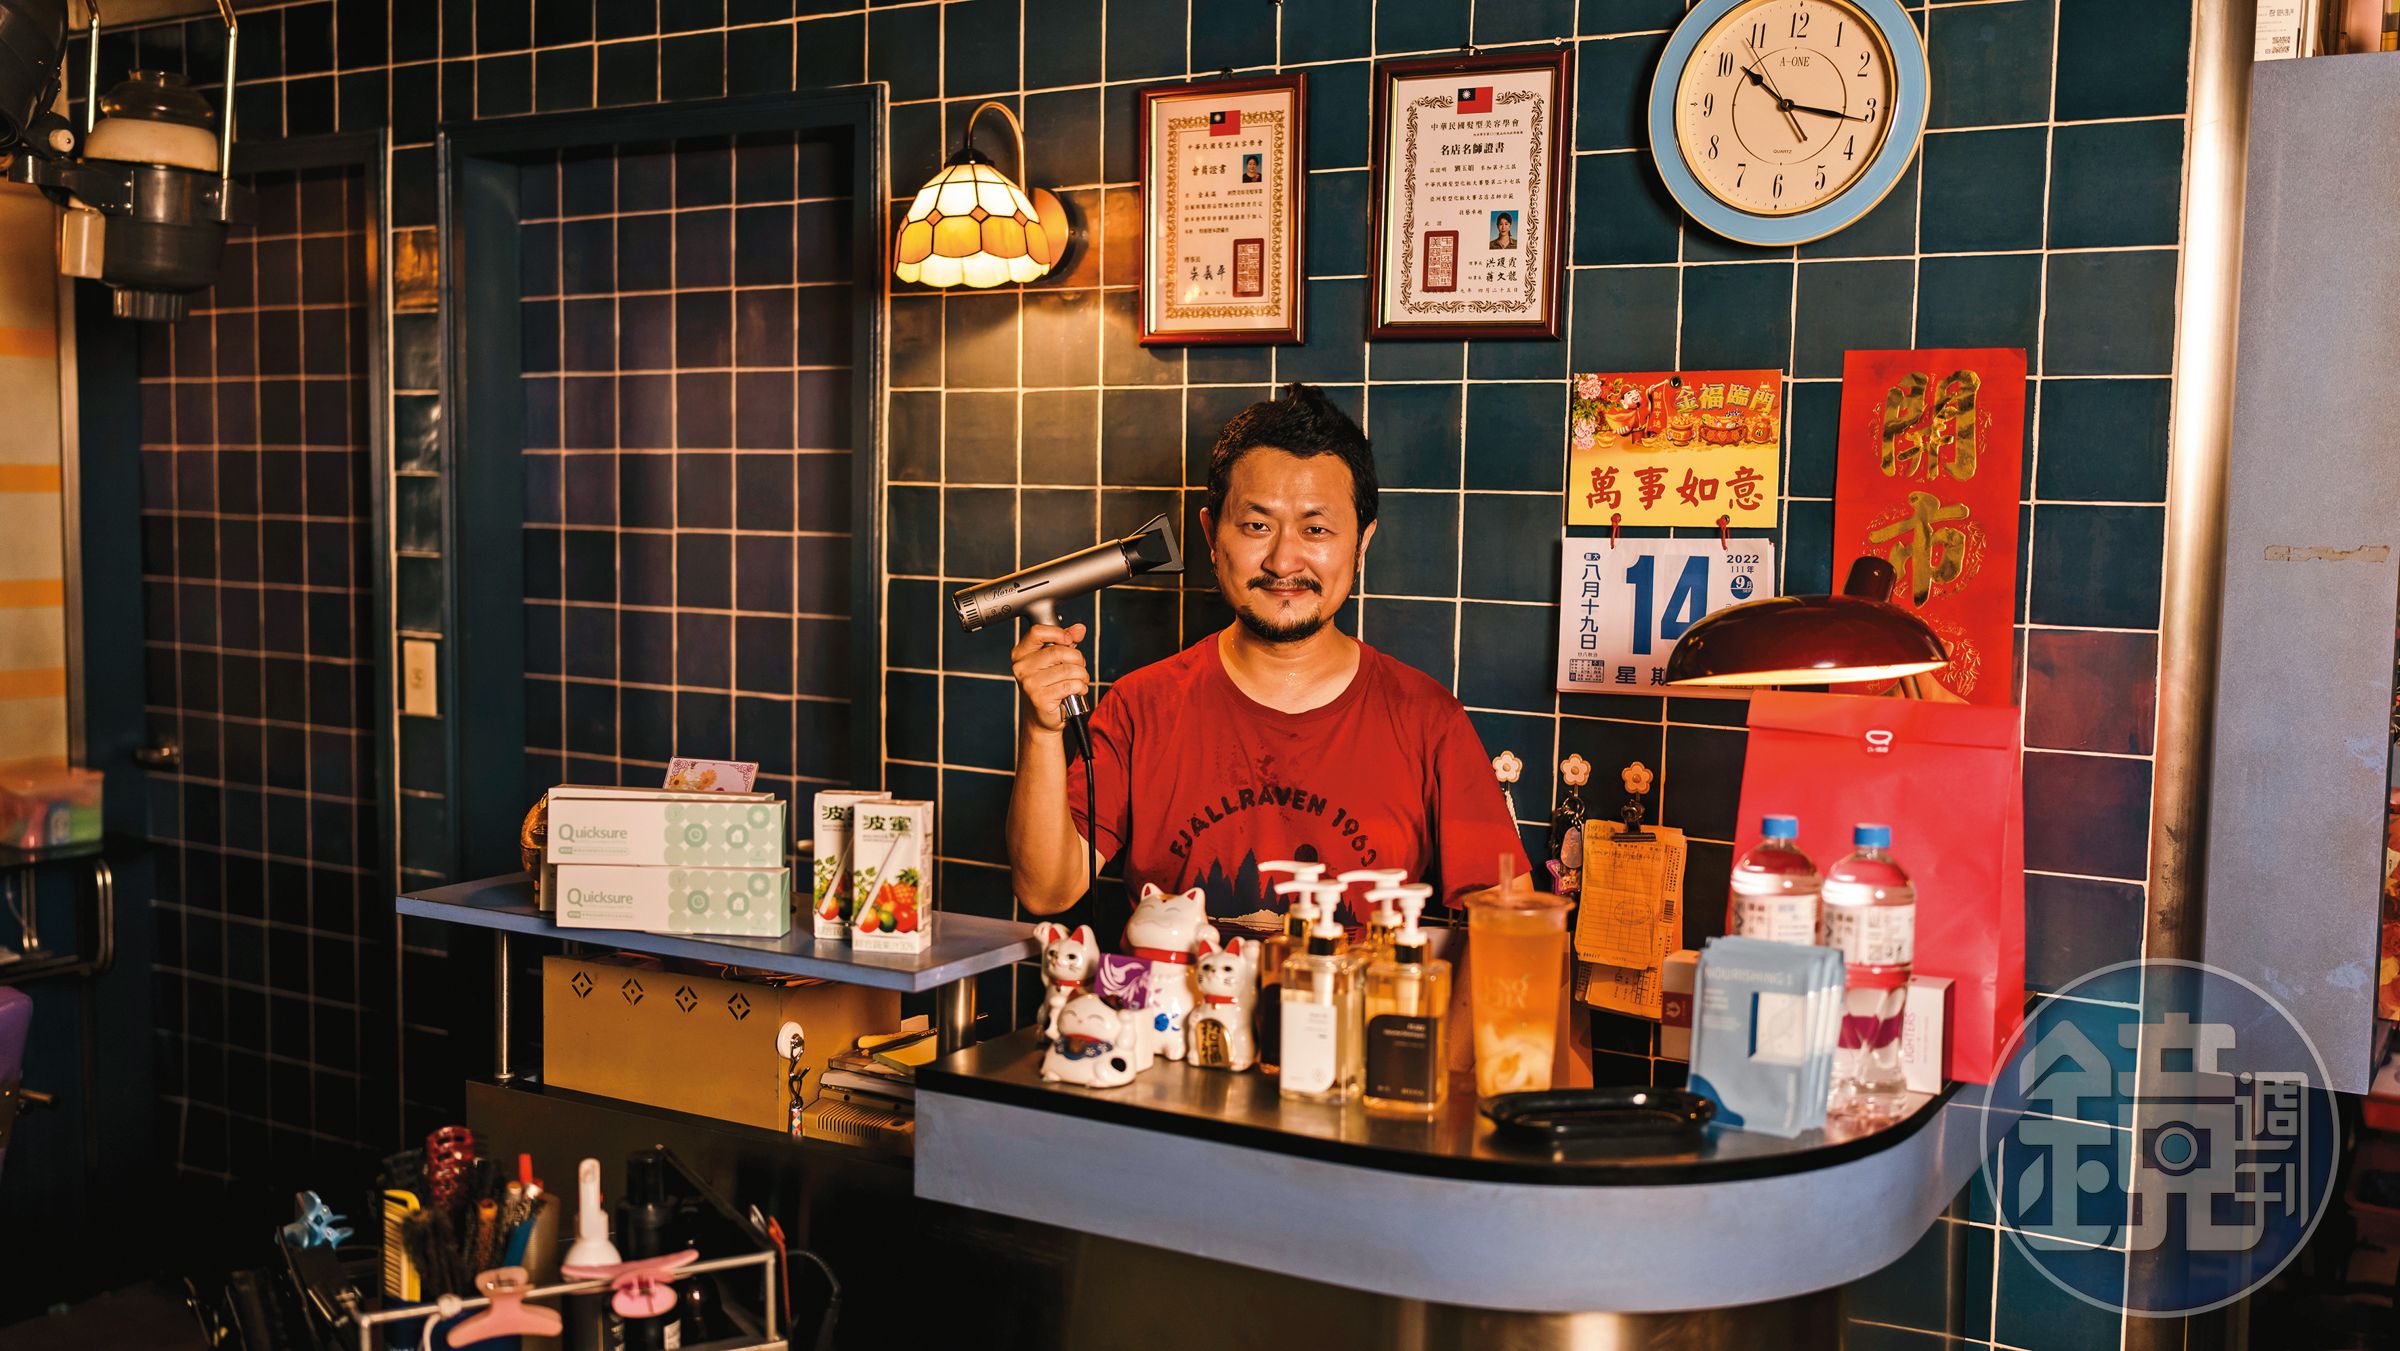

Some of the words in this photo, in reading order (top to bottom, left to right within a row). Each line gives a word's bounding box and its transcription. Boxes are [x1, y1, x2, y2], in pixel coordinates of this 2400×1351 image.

[1750, 23, 1766, 49] 11
[1789, 12, 1809, 38] 12
[1835, 21, 1843, 48] 1
[1716, 52, 1734, 78] 10
[1780, 56, 1810, 68] A-ONE
[1857, 51, 1871, 77] 2
[1703, 93, 1714, 118] 9
[1864, 98, 1877, 123] 3
[1430, 118, 1519, 131] 中華民國髮型美容學會
[1440, 141, 1505, 156] 名店名師證書
[1708, 135, 1719, 160] 8
[1843, 135, 1854, 161] 4
[1192, 164, 1227, 176] 會員證書
[1736, 163, 1747, 188] 7
[1814, 164, 1826, 190] 5
[1772, 174, 1783, 200] 6
[1675, 383, 1776, 415] 金福臨門
[1586, 465, 1764, 511] 萬事如意
[1726, 554, 1760, 564] 2022
[1580, 564, 1601, 650] 八月十九日
[1625, 554, 1710, 655] 14
[558, 823, 628, 843] Quicksure
[863, 815, 912, 832] 波蜜
[567, 887, 633, 907] Quicksure
